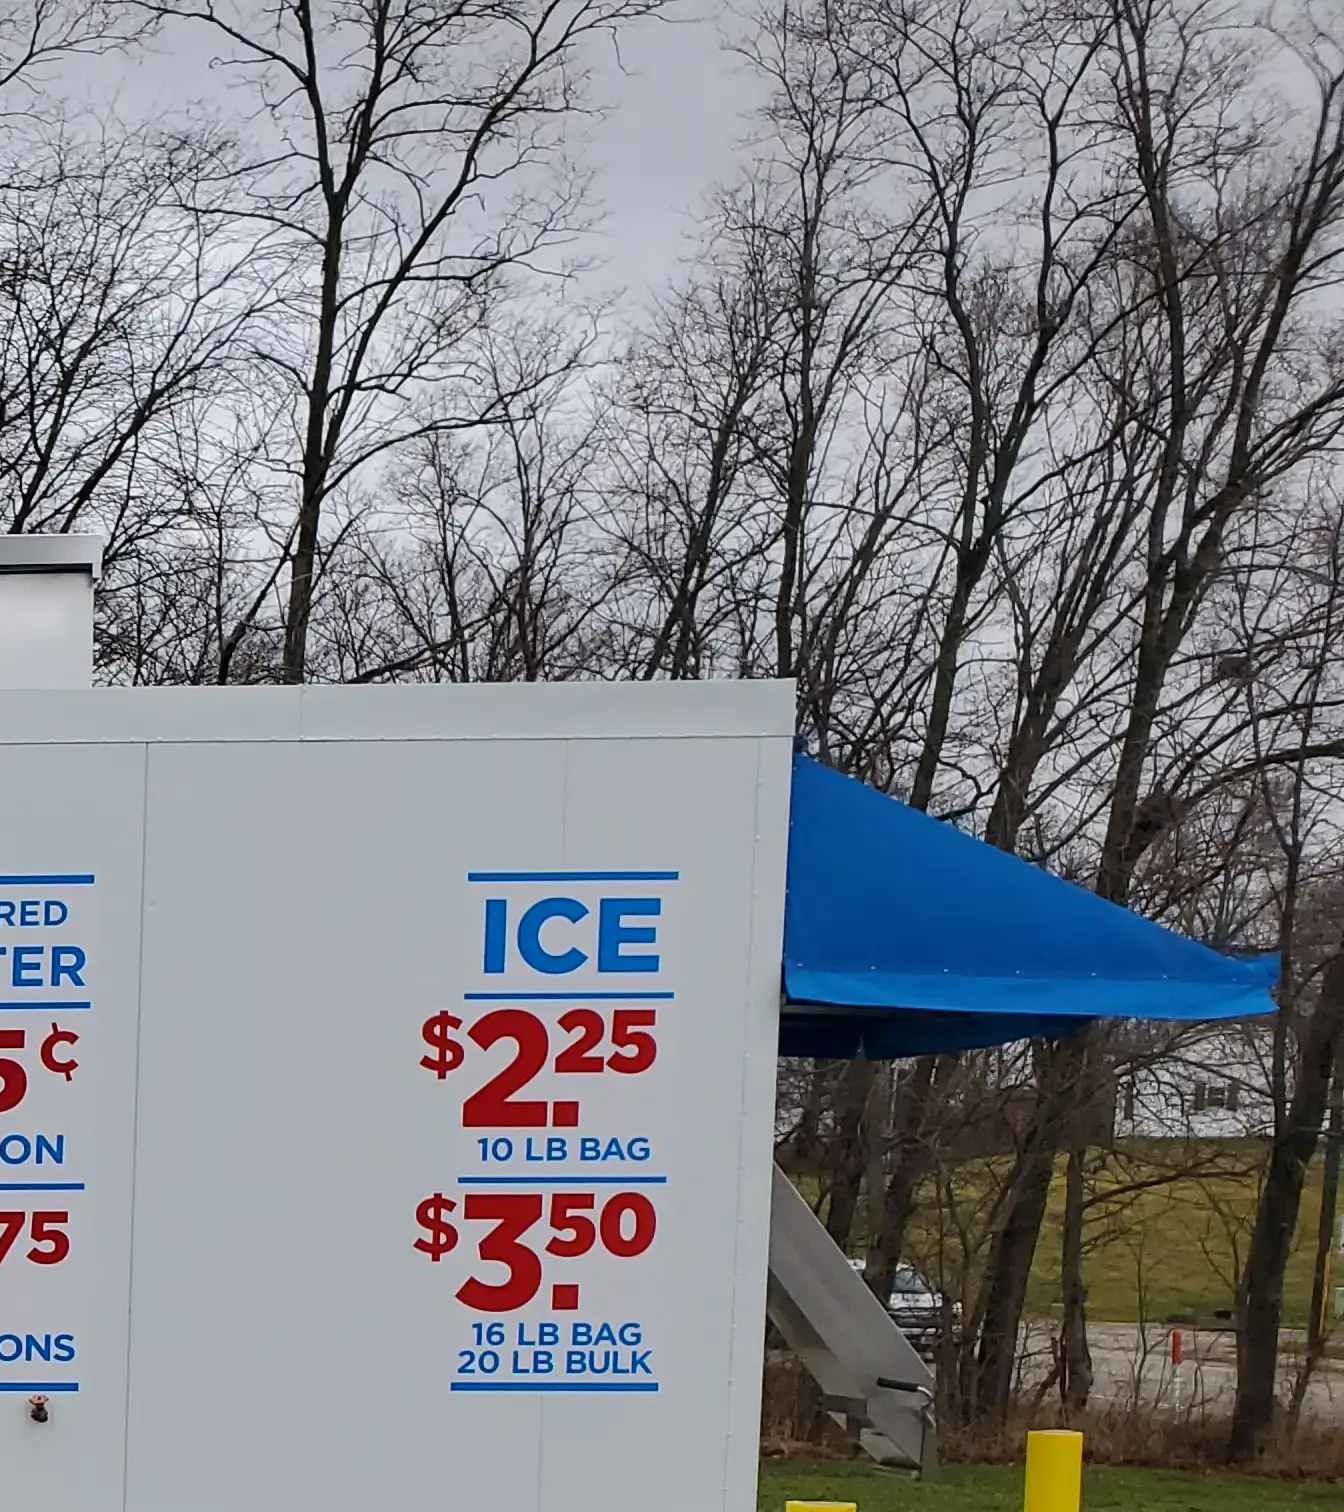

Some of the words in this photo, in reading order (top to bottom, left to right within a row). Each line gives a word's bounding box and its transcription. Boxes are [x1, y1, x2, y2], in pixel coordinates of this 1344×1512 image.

[483, 897, 663, 976] ICE
[419, 1008, 657, 1128] $2.25
[477, 1136, 514, 1162] 10
[525, 1137, 569, 1162] LB
[580, 1136, 652, 1162] BAG
[413, 1191, 657, 1312] $3.50
[472, 1321, 506, 1347] 16
[517, 1321, 560, 1347] LB
[572, 1321, 644, 1347] BAG
[457, 1350, 502, 1375] 20
[513, 1350, 556, 1375] LB
[566, 1350, 653, 1375] BULK
